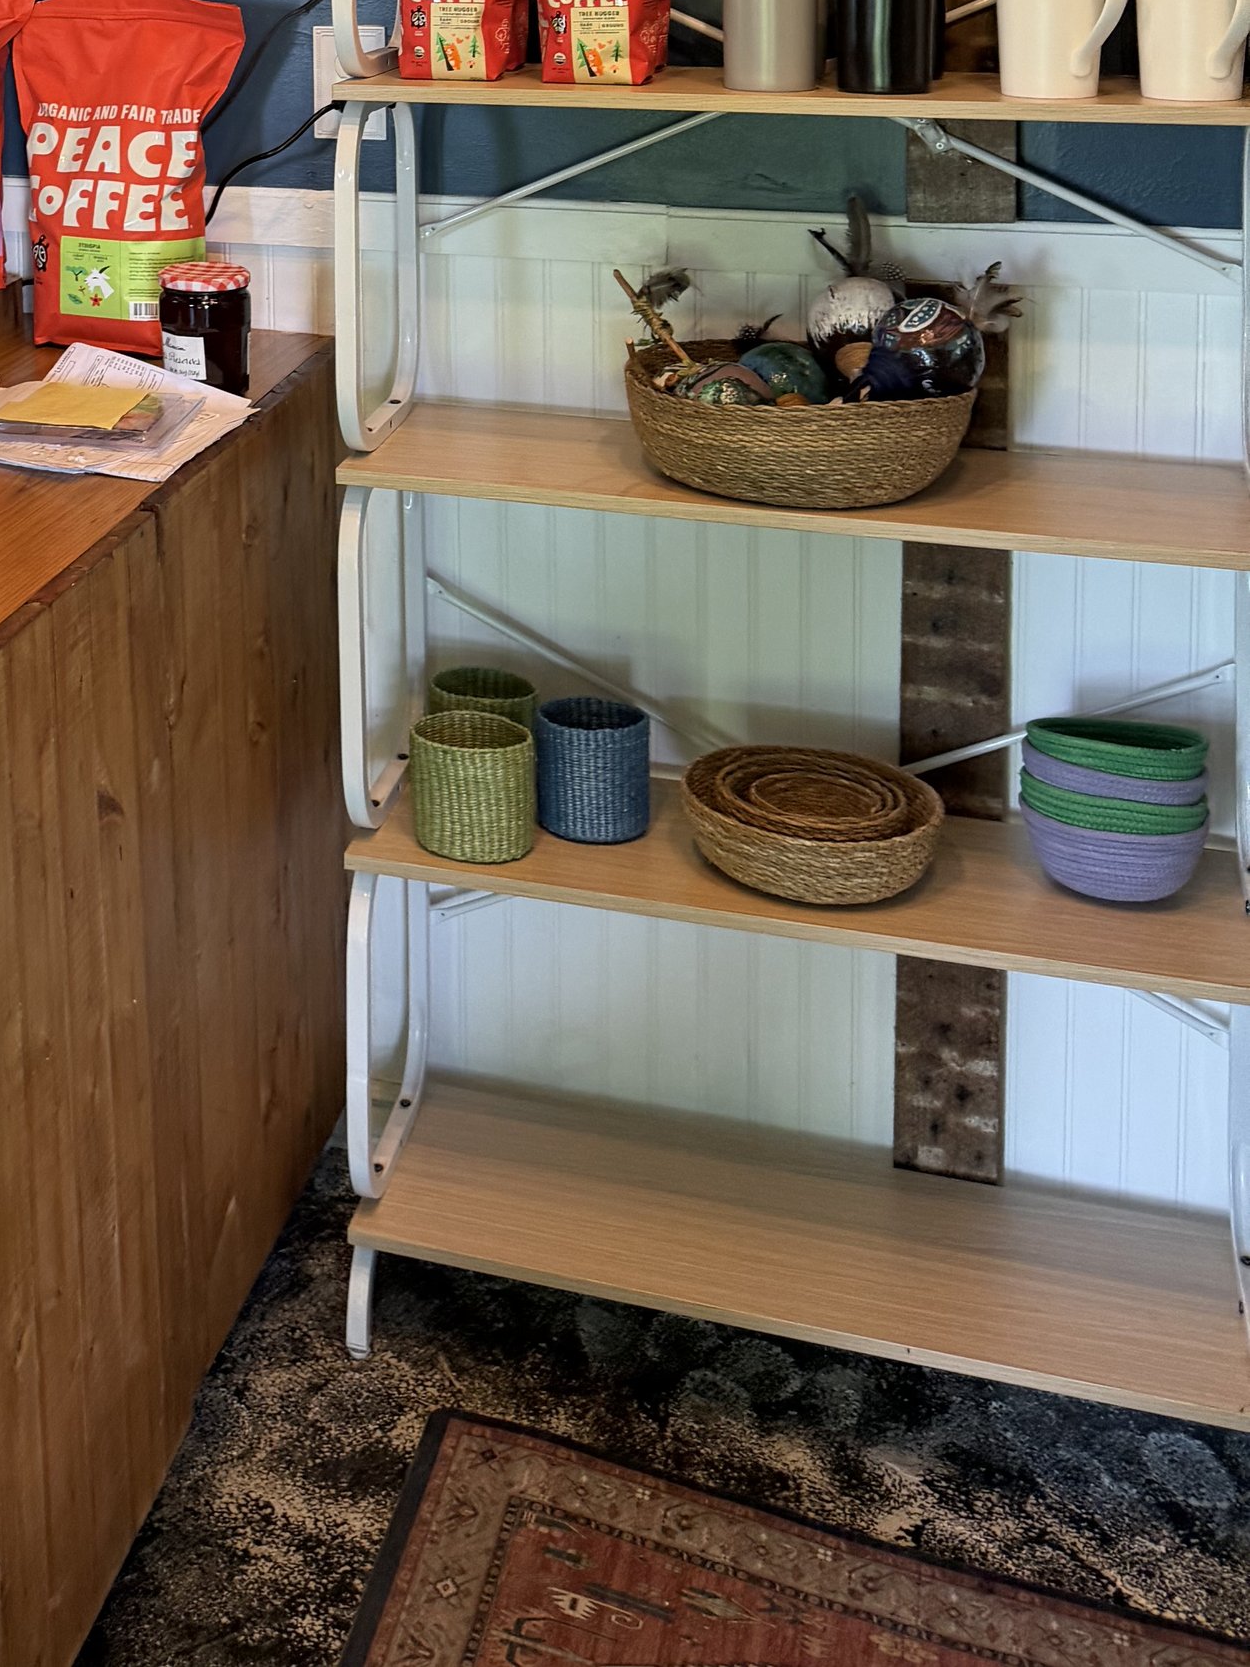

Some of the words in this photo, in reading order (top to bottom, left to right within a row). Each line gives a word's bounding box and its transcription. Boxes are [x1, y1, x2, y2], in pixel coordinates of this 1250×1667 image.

[37, 103, 92, 121] ORGANIC
[93, 105, 118, 120] AND
[121, 104, 155, 124] FAIR
[161, 108, 201, 125] TRADE
[26, 122, 199, 179] PEACE
